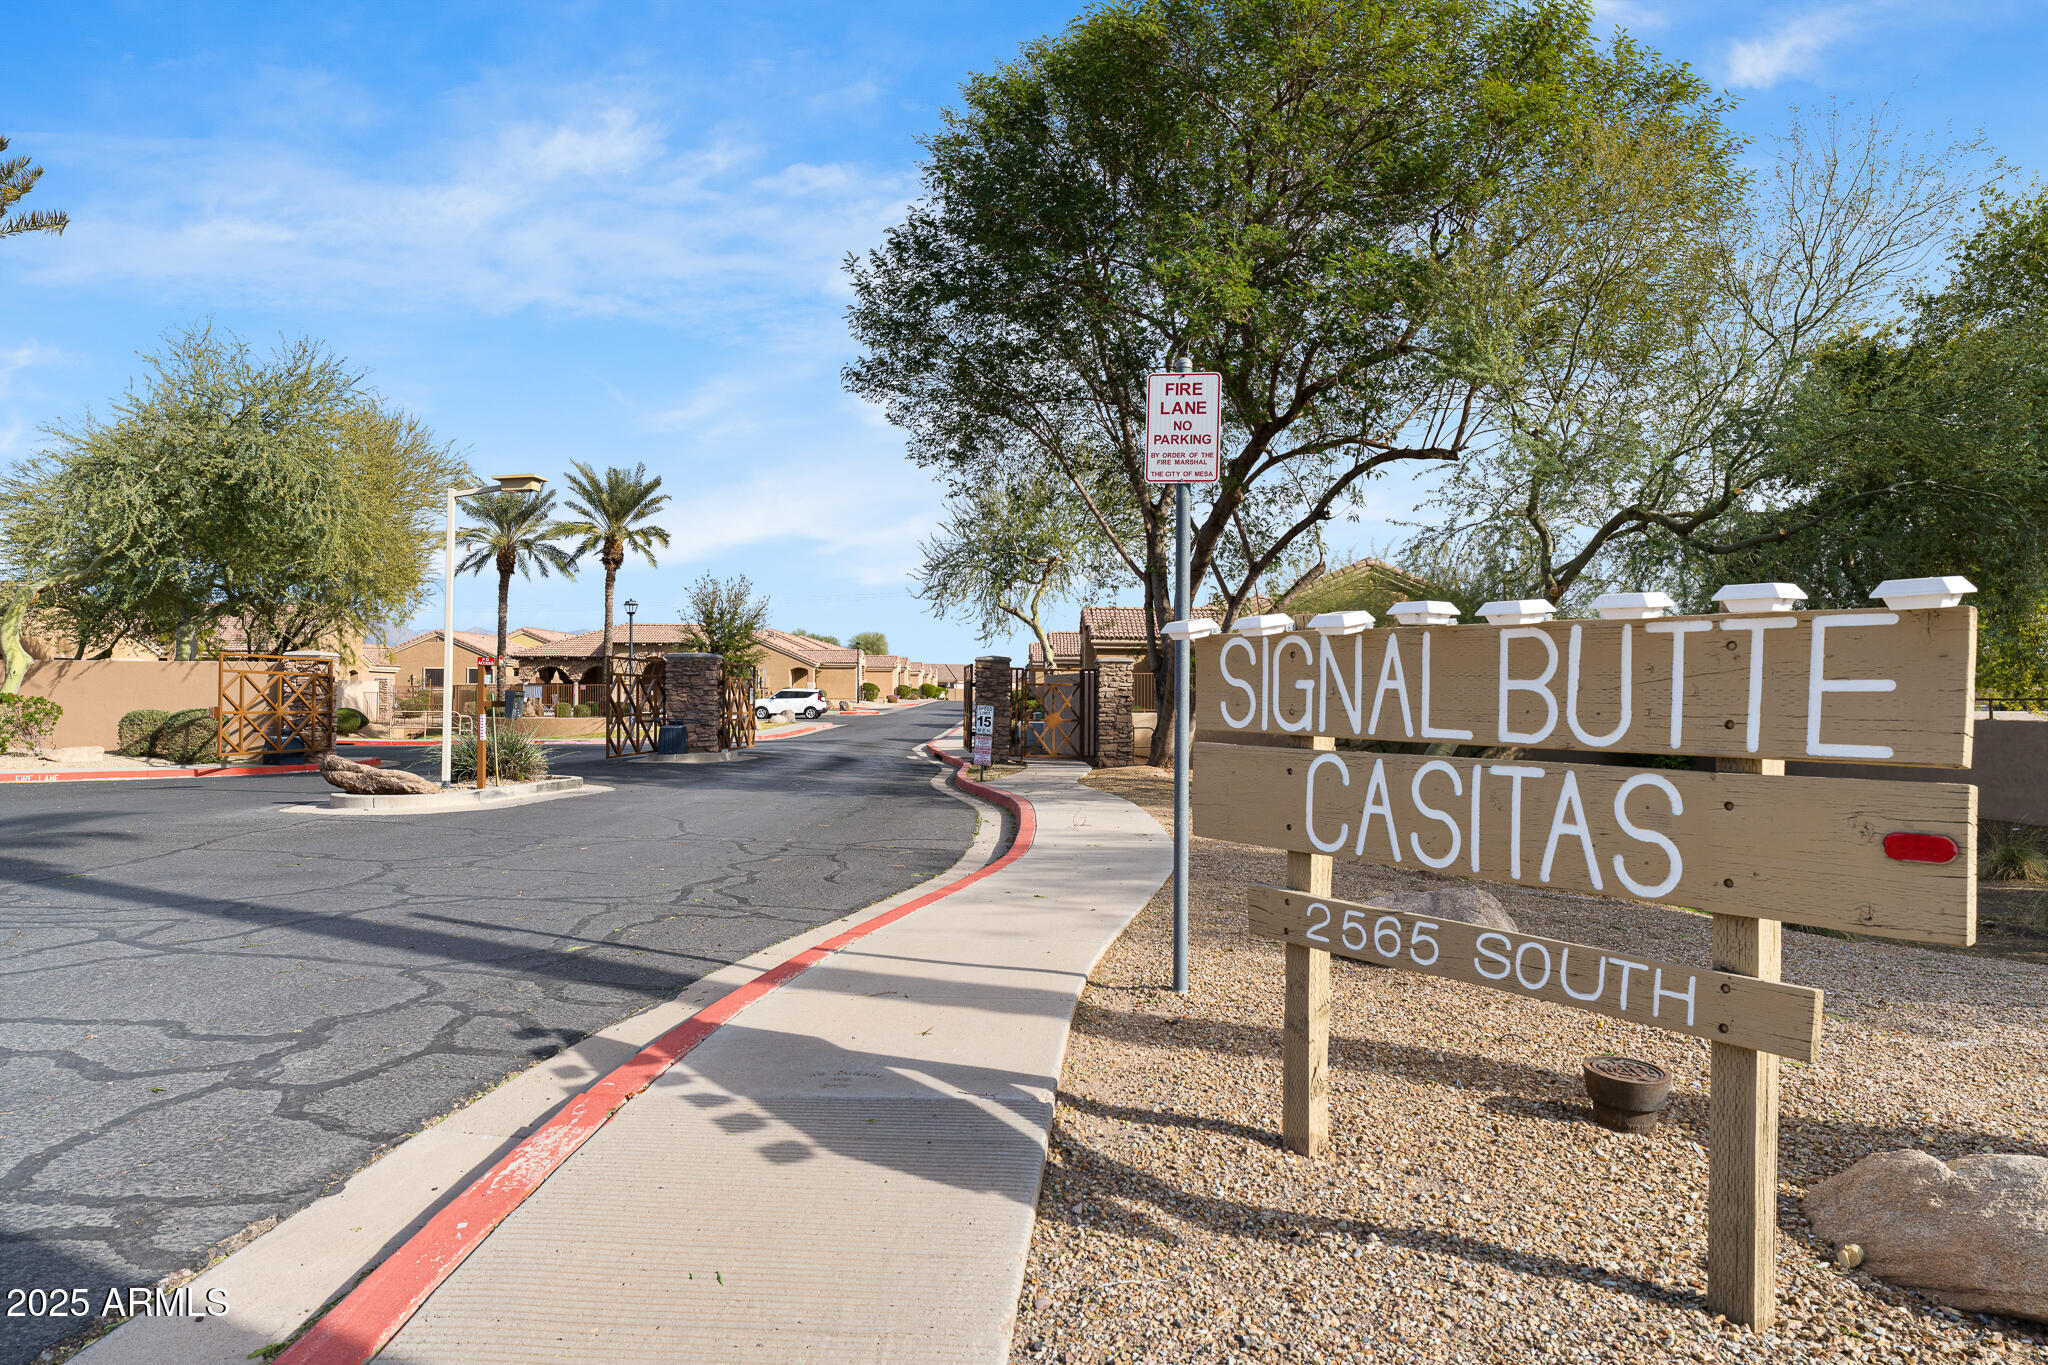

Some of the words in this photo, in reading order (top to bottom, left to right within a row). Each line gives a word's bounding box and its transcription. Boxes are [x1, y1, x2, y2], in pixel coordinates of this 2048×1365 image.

[1165, 382, 1203, 396] FIRE
[1160, 401, 1207, 415] LANE
[1173, 420, 1193, 431] NO
[1153, 434, 1212, 445] PARKING
[1219, 631, 1474, 741] SIGNAL
[1497, 612, 1901, 760] BUTTE
[977, 716, 992, 727] 15
[15, 774, 33, 782] FIRE
[38, 774, 60, 782] LANE
[1304, 752, 1684, 899] CASITAS
[1306, 902, 1440, 966] 2565
[1473, 931, 1697, 1027] SOUTH
